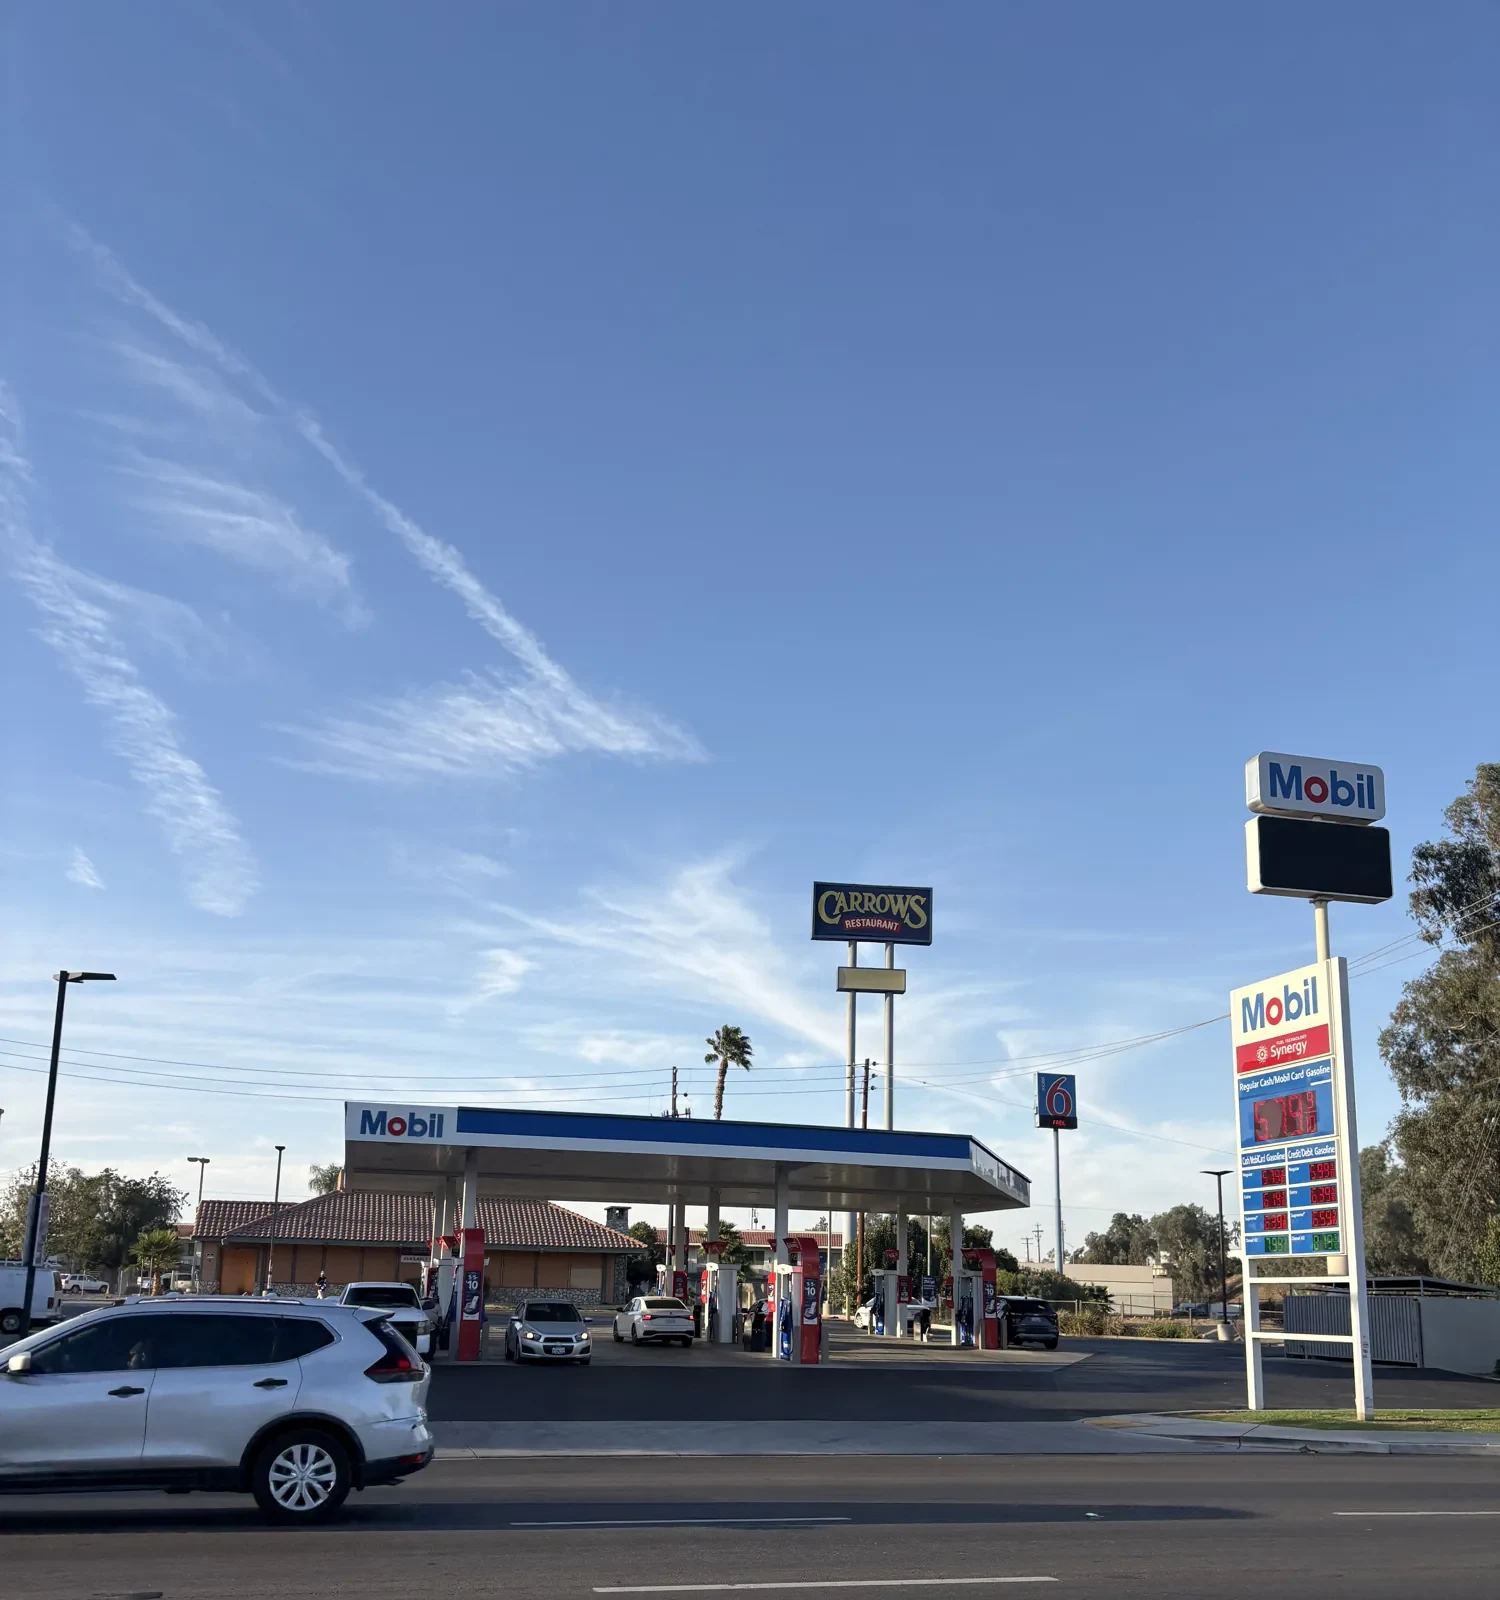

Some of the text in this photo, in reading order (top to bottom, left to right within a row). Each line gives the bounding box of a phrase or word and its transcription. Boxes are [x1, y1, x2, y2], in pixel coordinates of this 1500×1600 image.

[1269, 762, 1375, 810] Mobil
[817, 890, 928, 929] CARROWS
[844, 918, 900, 931] RESTAURANT
[1241, 976, 1319, 1034] Mobil
[1270, 1041, 1308, 1060] Synergy
[1239, 1066, 1331, 1092] Regular Cash/Mobil Card Gasoline
[1045, 1076, 1073, 1117] 6
[360, 1109, 444, 1138] Mobil
[1266, 1151, 1286, 1162] Gasoline
[1314, 1145, 1335, 1155] Gasoline
